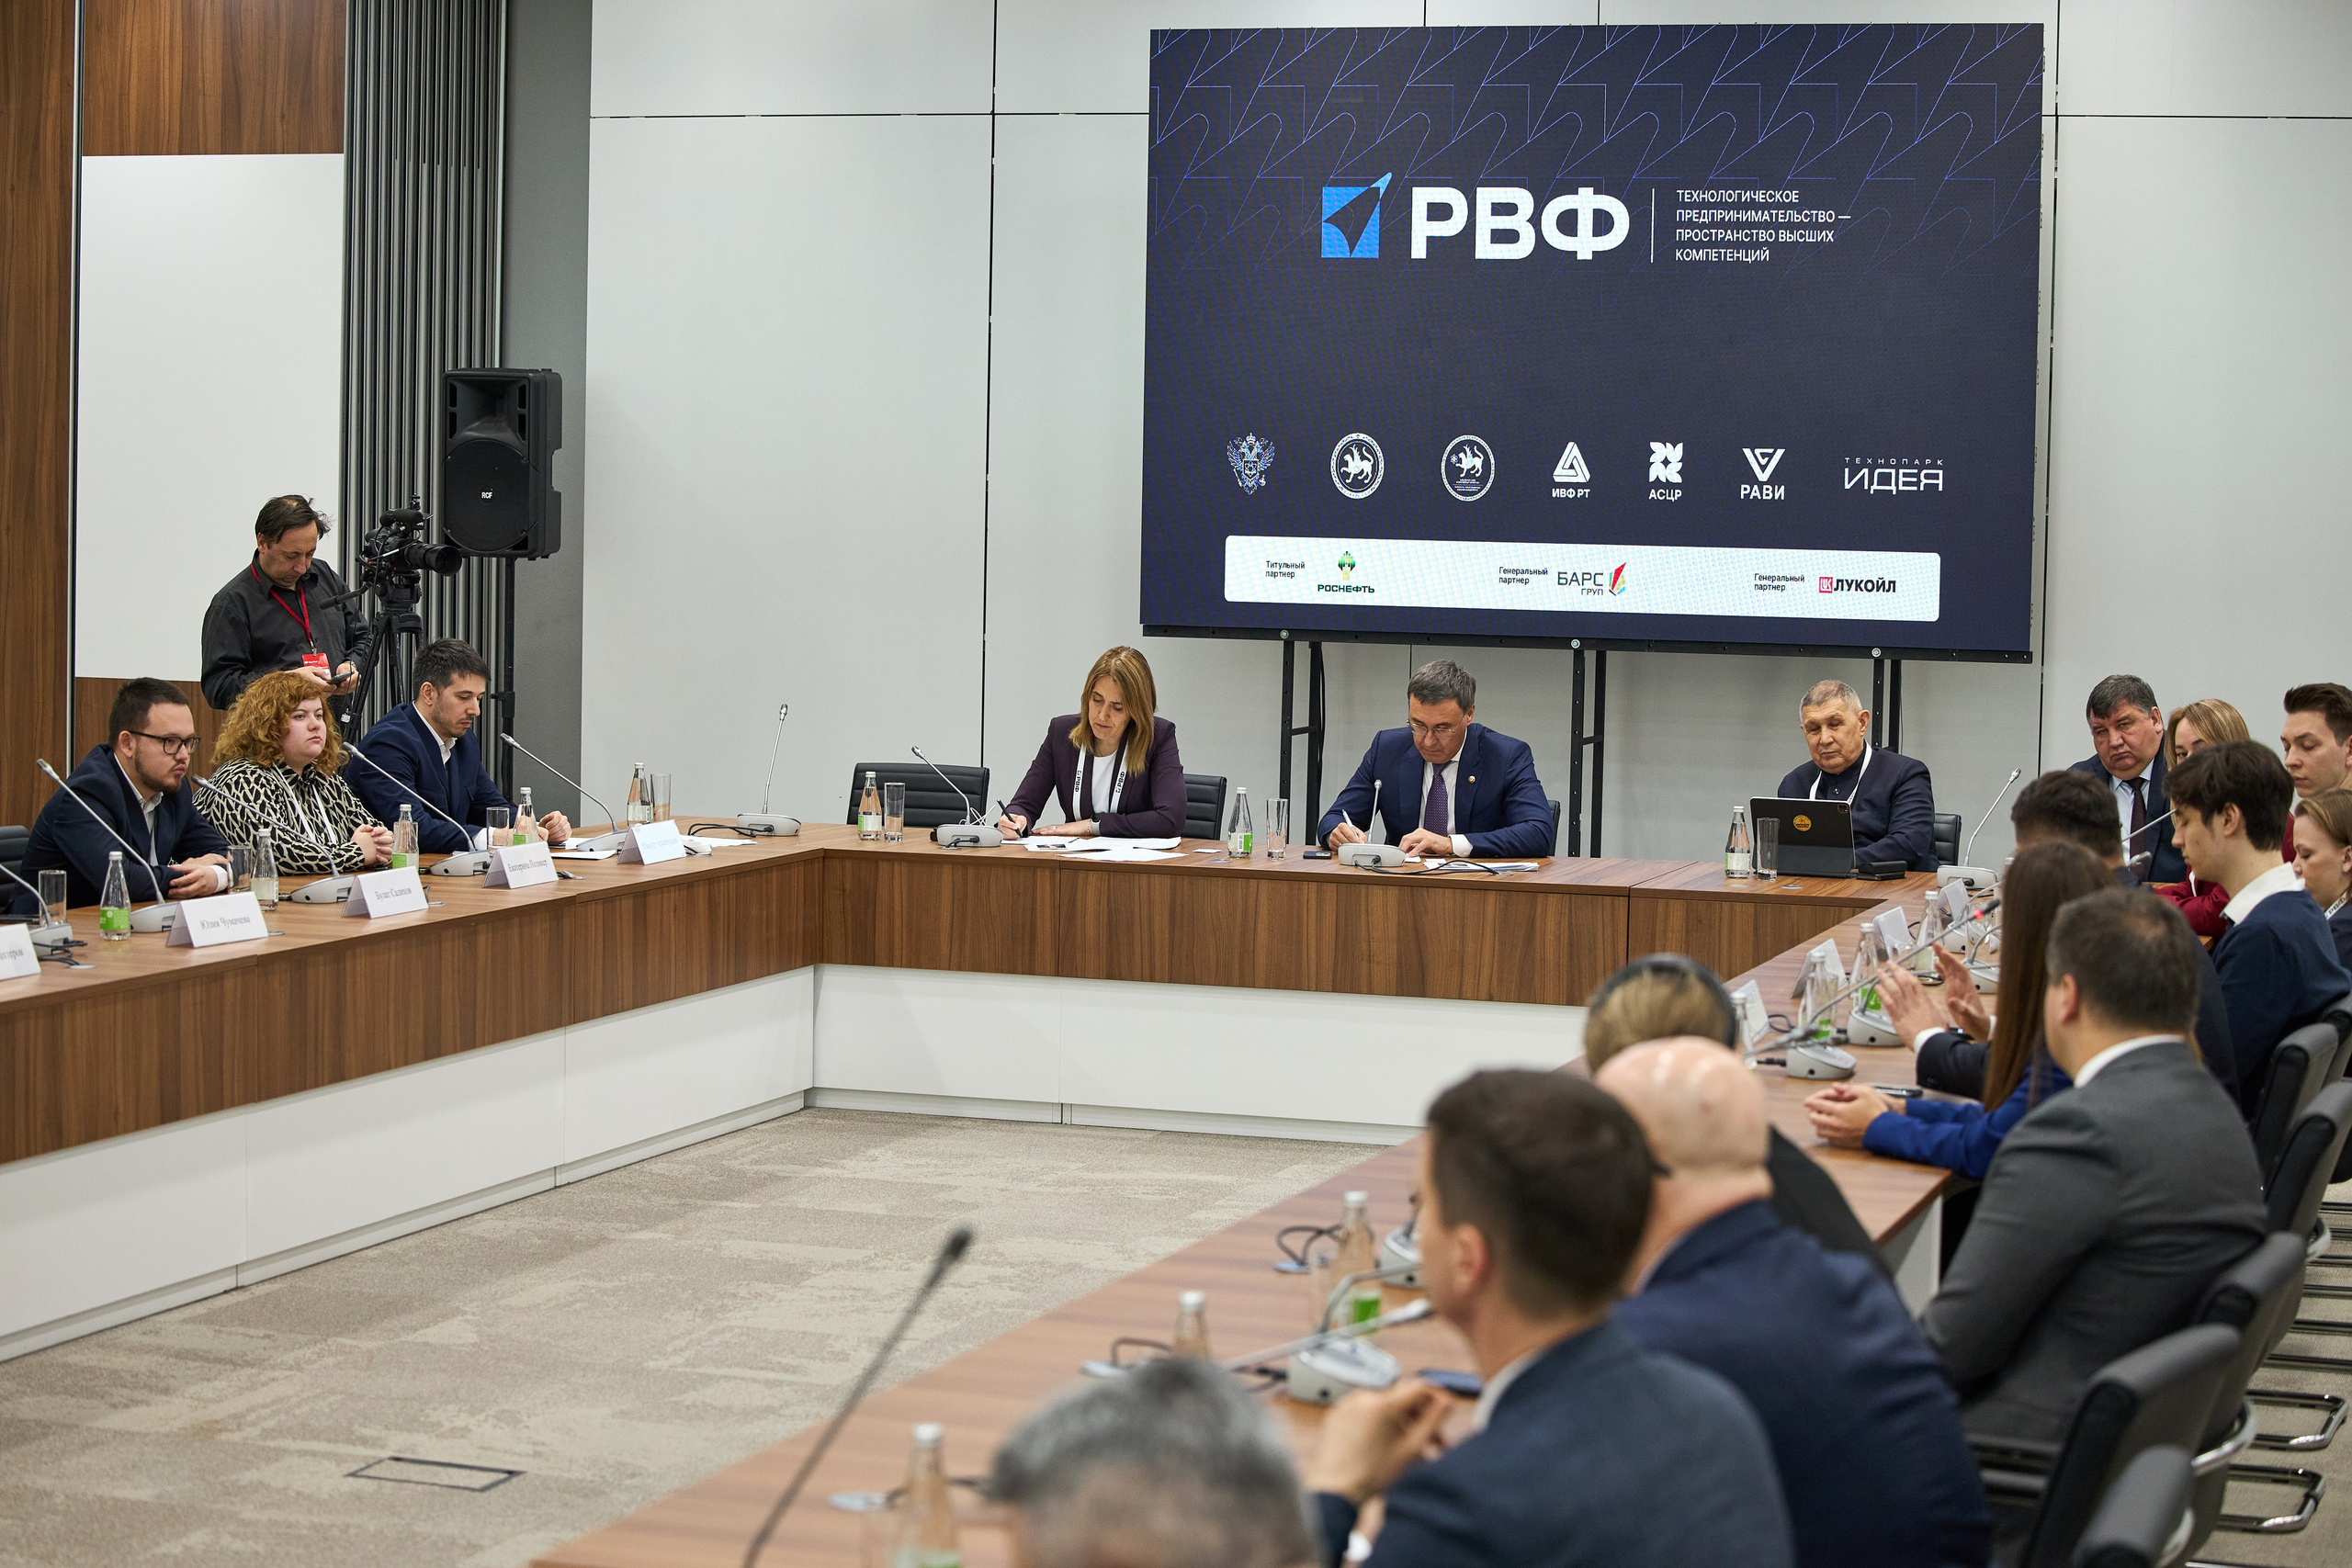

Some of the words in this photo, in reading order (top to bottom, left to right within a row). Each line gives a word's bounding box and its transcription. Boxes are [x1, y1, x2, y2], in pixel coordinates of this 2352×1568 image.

[1676, 189, 1800, 203] ТЕХНОЛОГИЧЕСКОЕ
[1676, 209, 1836, 224] ПРЕДПРИНИМАТЕЛЬСТВО
[1410, 186, 1630, 260] РВФ
[1676, 229, 1776, 243] ПРОСТРАНСТВО
[1778, 230, 1835, 243] ВЫСШИХ
[1675, 246, 1770, 264] КОМПЕТЕНЦИЙ
[1844, 457, 1943, 466] ТЕХНОПАРК
[1844, 468, 1943, 495] ИДЕЯ
[1552, 488, 1576, 499] ИВФ
[1577, 488, 1591, 499] РТ
[1648, 489, 1682, 502] АСЦР
[1740, 484, 1785, 501] РАВИ
[1265, 560, 1306, 570] Титульный
[1265, 570, 1295, 580] партнер
[1498, 566, 1548, 577] Генеральный
[1754, 572, 1805, 583] Генеральный
[1498, 575, 1530, 586] партнер
[1557, 571, 1604, 587] БАРС
[1834, 577, 1896, 593] ЛУКОЙЛ
[1317, 584, 1375, 593] РОСНЕФТЬ
[1580, 588, 1604, 596] ГРУП
[1754, 582, 1786, 592] партнер
[199, 919, 220, 931] Юлия
